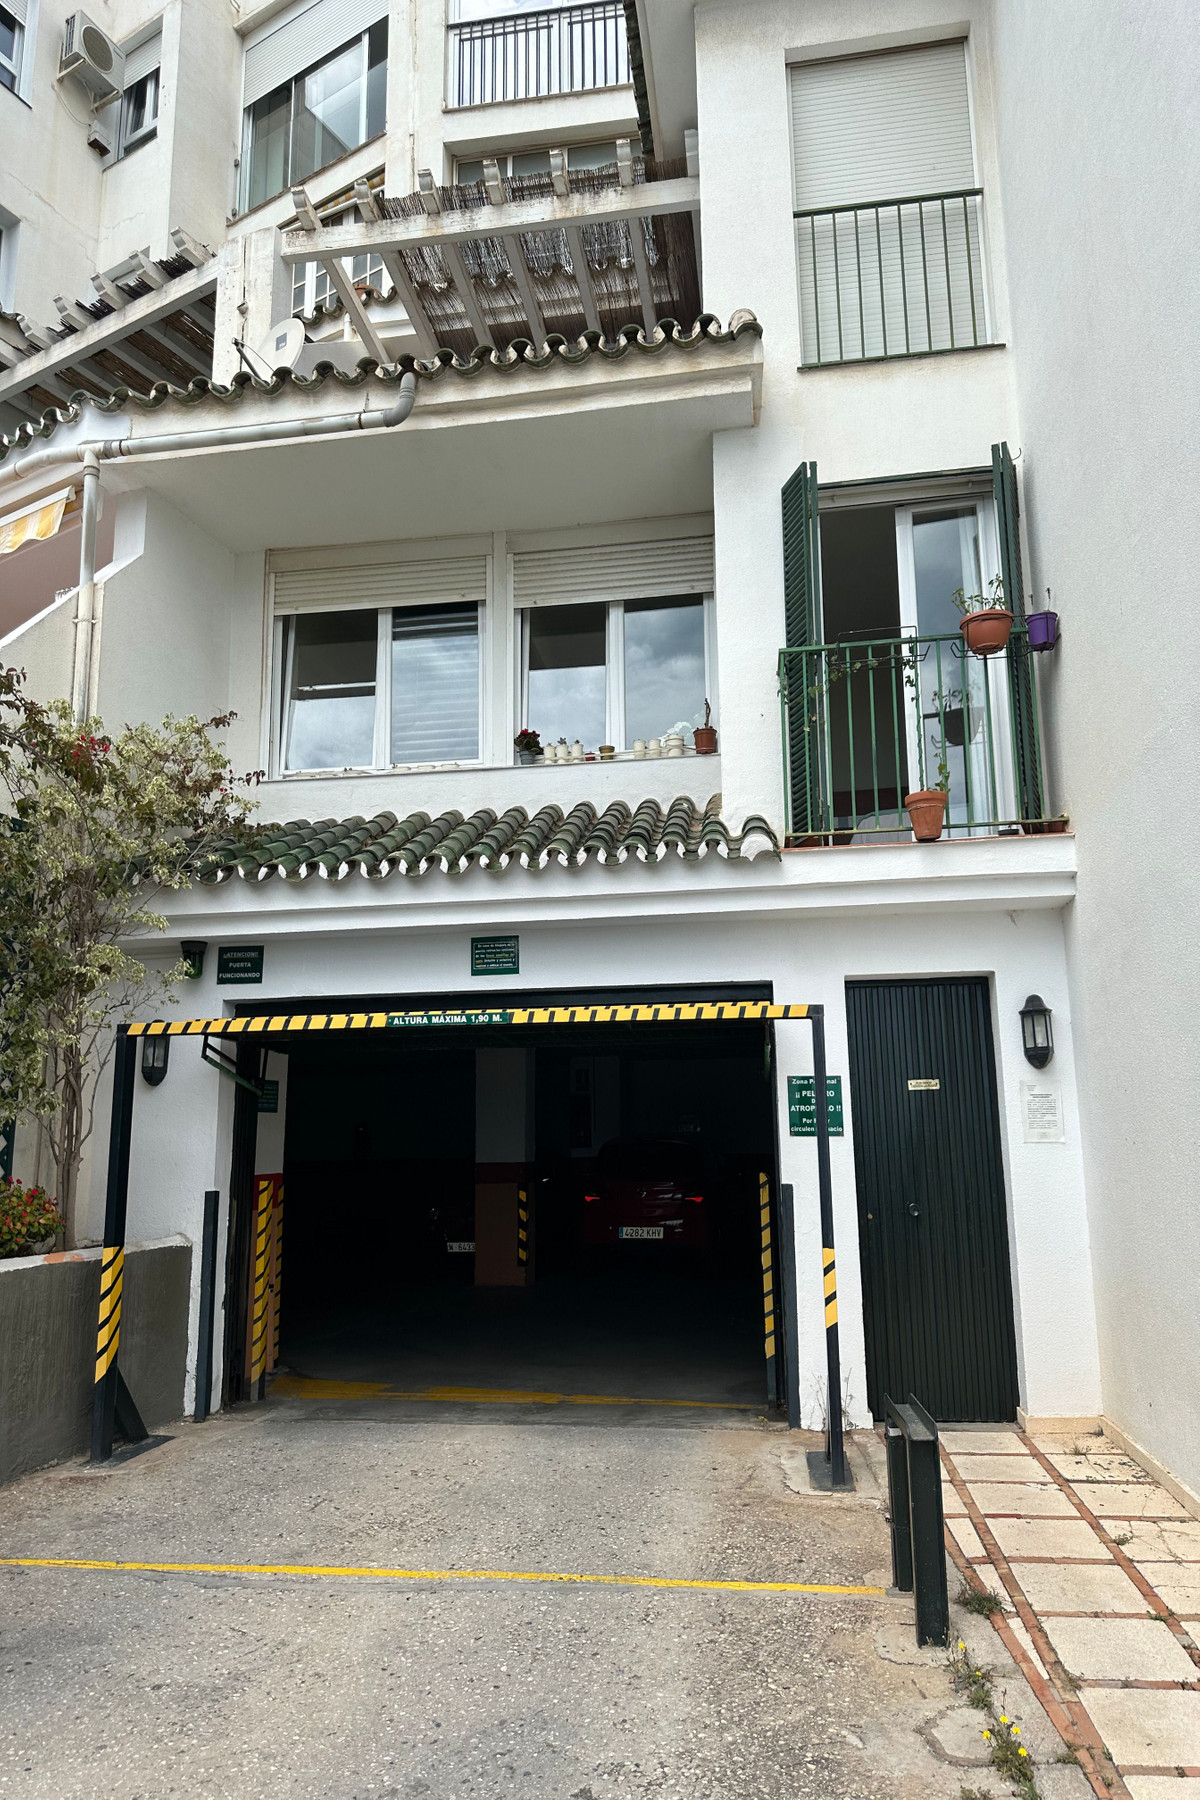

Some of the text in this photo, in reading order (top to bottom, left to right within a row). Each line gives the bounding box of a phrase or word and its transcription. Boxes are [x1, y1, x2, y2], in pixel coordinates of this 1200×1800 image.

[393, 1014, 503, 1025] ALTURA MÁXIMA 1,90 M.
[624, 1228, 662, 1238] 4282 KHV
